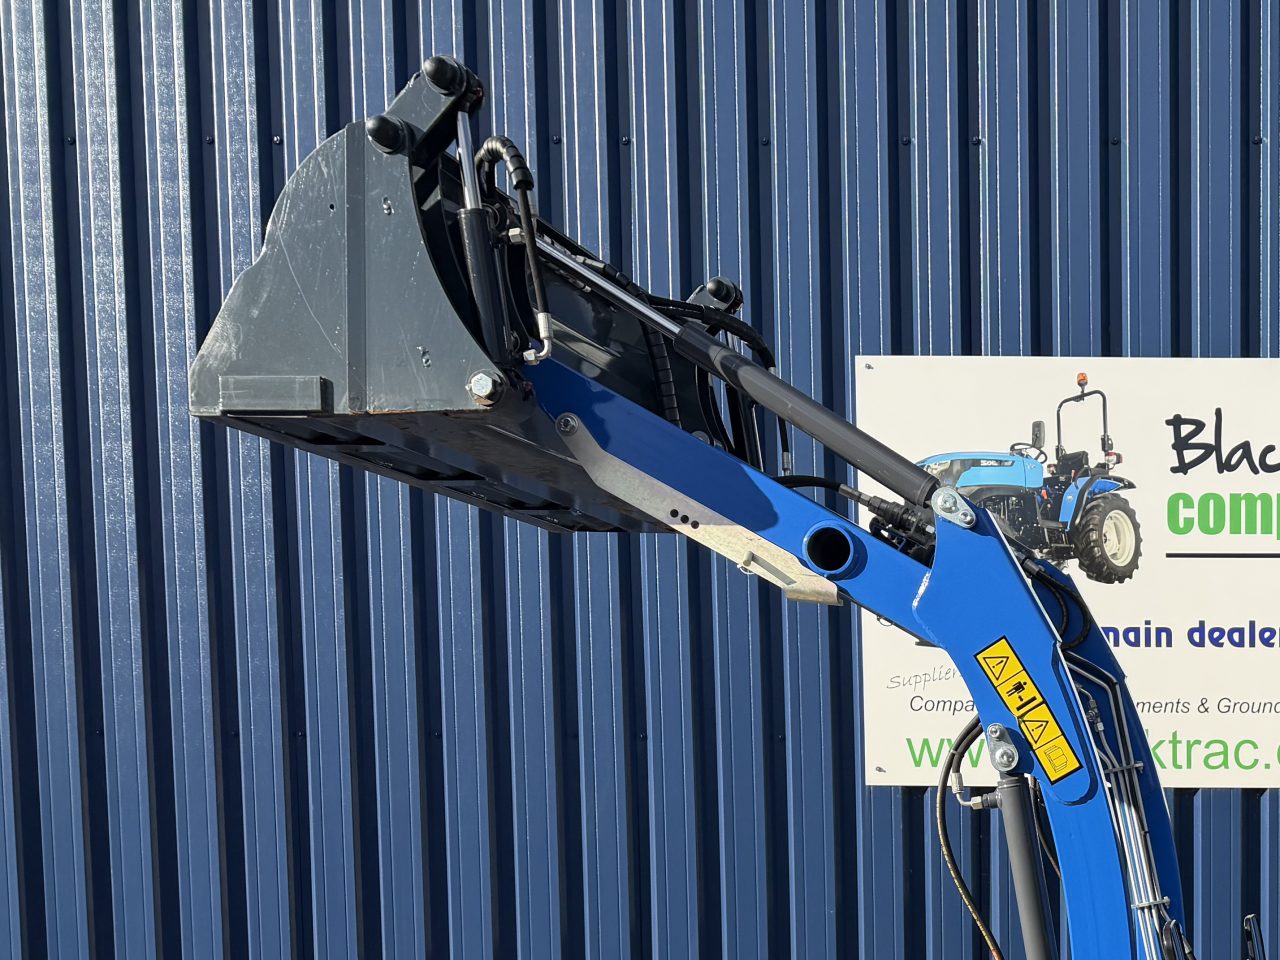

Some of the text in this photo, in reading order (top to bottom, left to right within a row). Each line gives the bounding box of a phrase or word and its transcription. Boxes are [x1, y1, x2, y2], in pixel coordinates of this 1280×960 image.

[886, 664, 958, 692] Supplier
[910, 695, 975, 716] Compa
[1197, 697, 1210, 714] &
